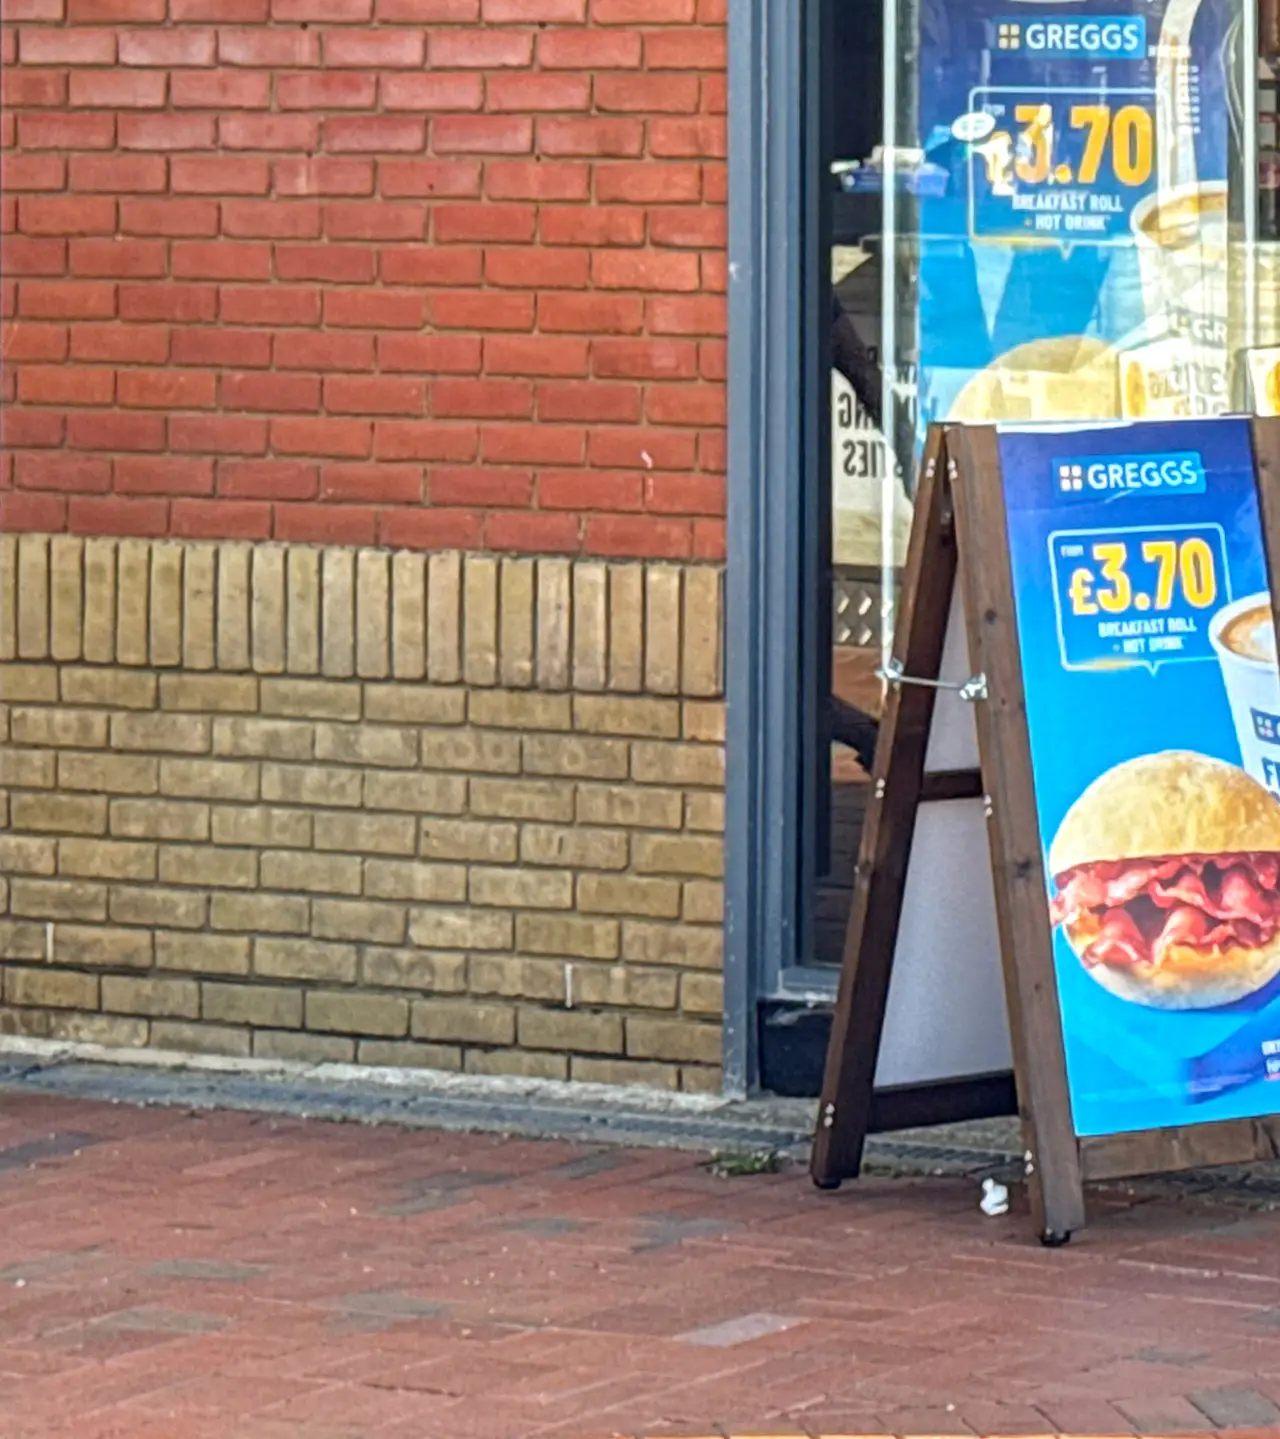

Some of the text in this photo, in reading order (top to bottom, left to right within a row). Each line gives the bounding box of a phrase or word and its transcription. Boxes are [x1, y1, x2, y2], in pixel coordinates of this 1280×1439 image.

[1025, 22, 1140, 52] GREGGS
[1089, 194, 1123, 212] ROLL
[1088, 460, 1198, 491] GREGGS
[1068, 537, 1217, 615] £3.70
